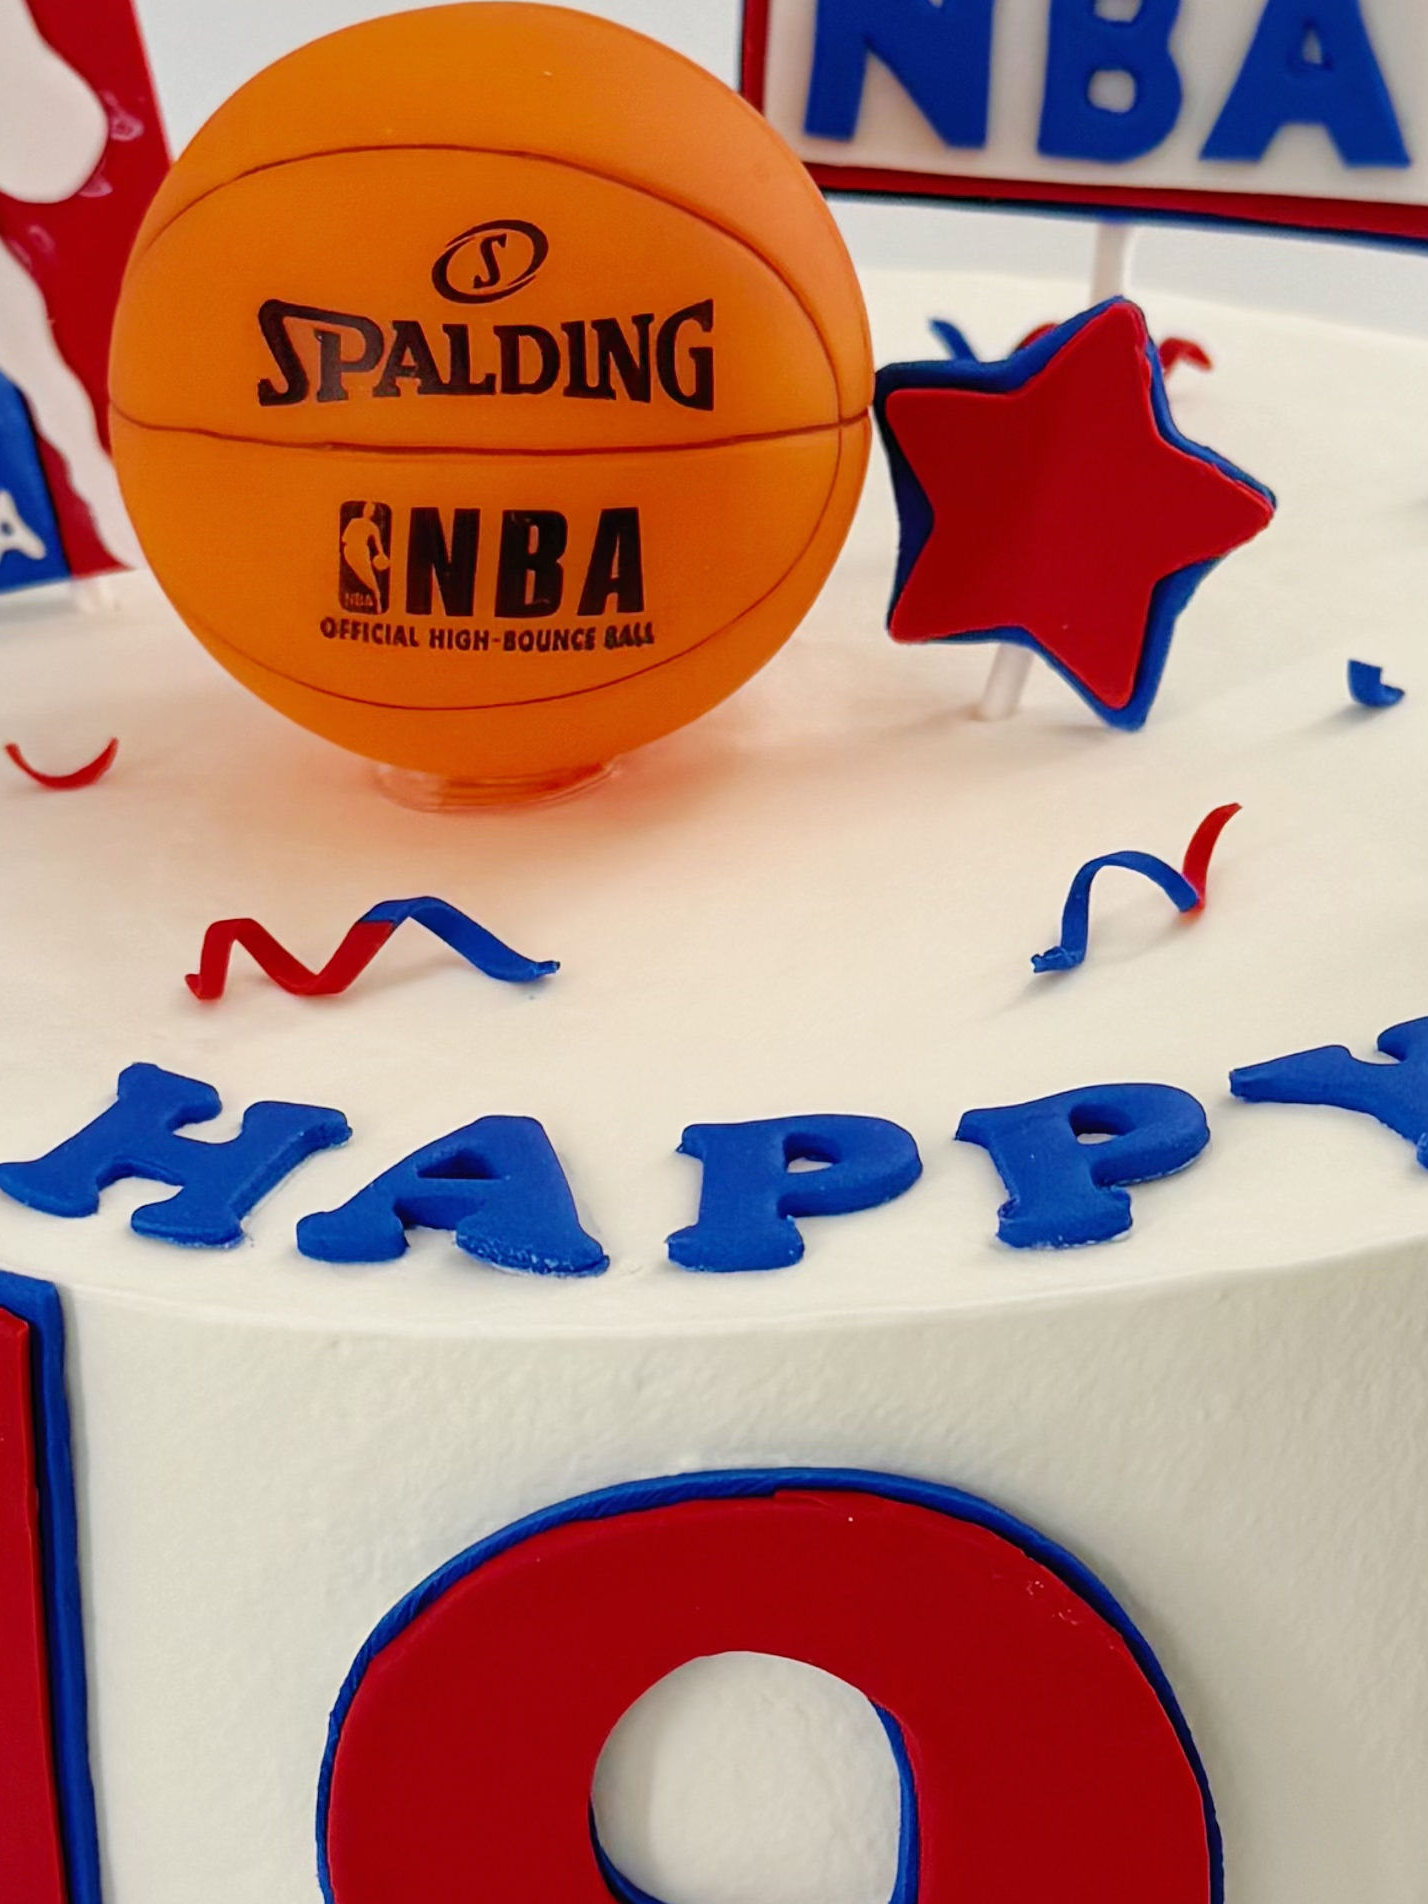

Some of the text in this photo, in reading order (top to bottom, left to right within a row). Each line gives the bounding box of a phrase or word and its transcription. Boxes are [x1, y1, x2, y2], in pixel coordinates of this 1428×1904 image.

[257, 299, 714, 412] SPALDING
[405, 506, 645, 619] NBA
[320, 616, 655, 653] OFFICIAL HIGH-BOUNCE BALL
